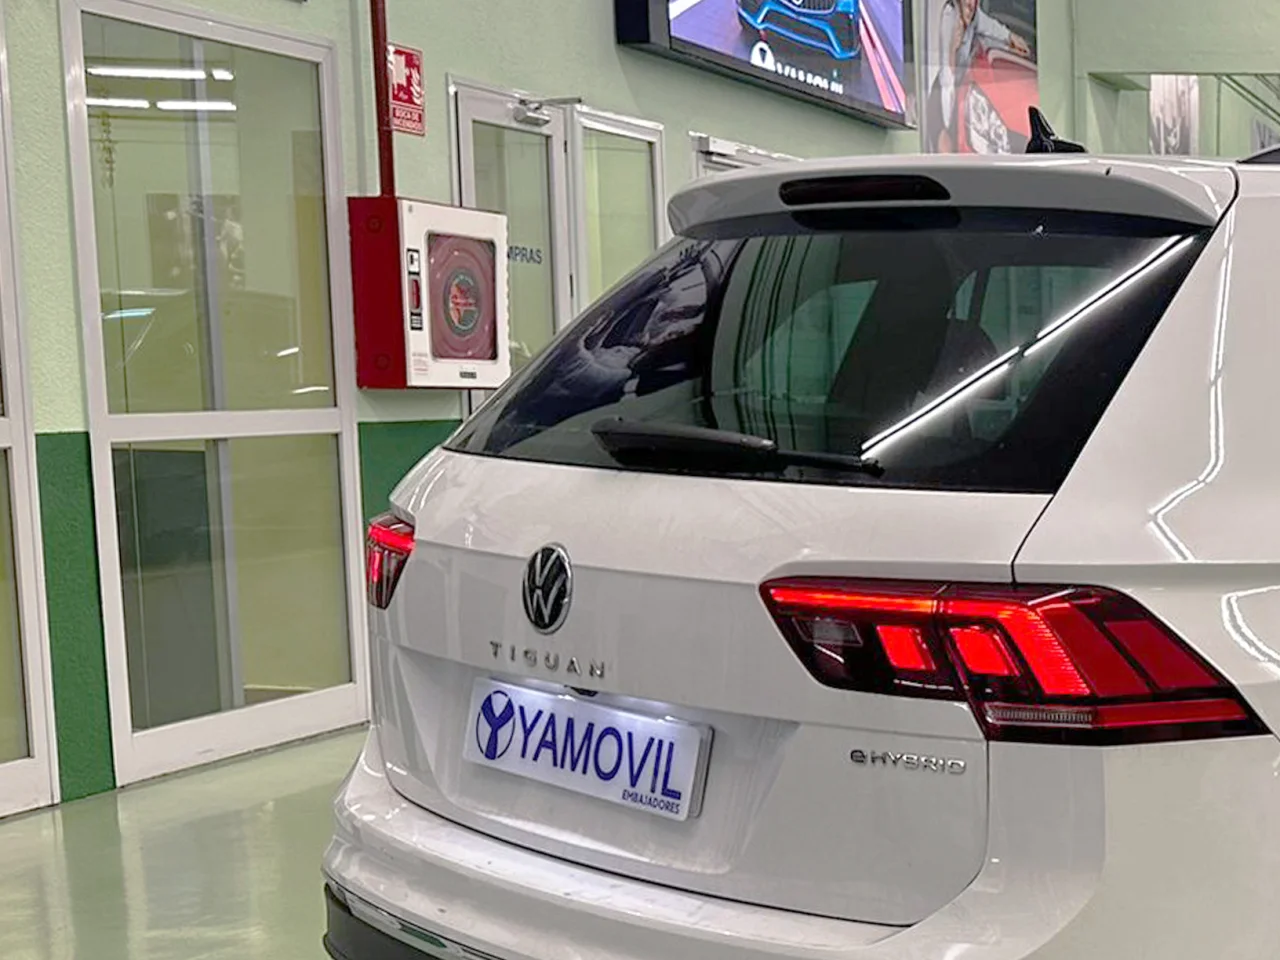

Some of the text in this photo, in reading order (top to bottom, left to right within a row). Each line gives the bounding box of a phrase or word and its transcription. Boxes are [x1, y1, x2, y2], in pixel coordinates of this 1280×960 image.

[507, 245, 542, 265] MPRAS
[489, 640, 606, 679] TIGUAN
[518, 705, 682, 801] YAMOVIL
[621, 789, 681, 815] EMBAJADORES
